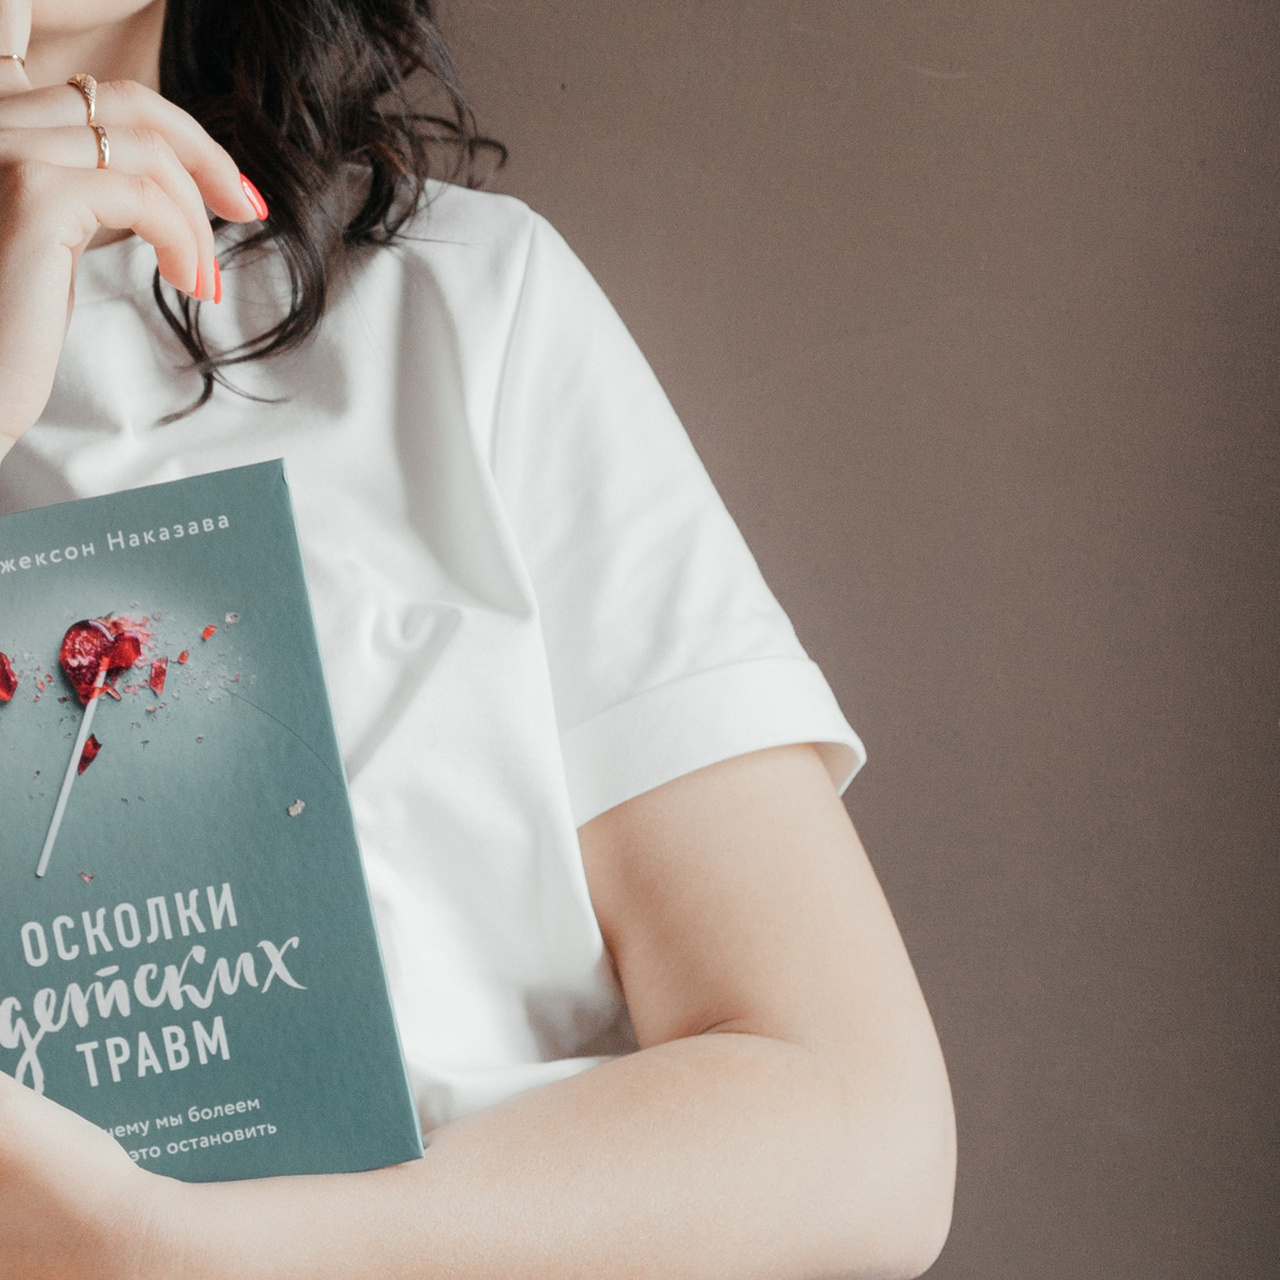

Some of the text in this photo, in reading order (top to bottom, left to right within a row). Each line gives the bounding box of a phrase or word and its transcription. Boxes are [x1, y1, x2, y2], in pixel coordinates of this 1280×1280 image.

[106, 514, 230, 552] Наказава
[20, 881, 239, 968] ОСКОЛКИ
[74, 1015, 231, 1088] ТРАВМ
[156, 1113, 184, 1130] мы
[187, 1098, 261, 1123] болеем
[128, 1122, 278, 1163] это остановить
